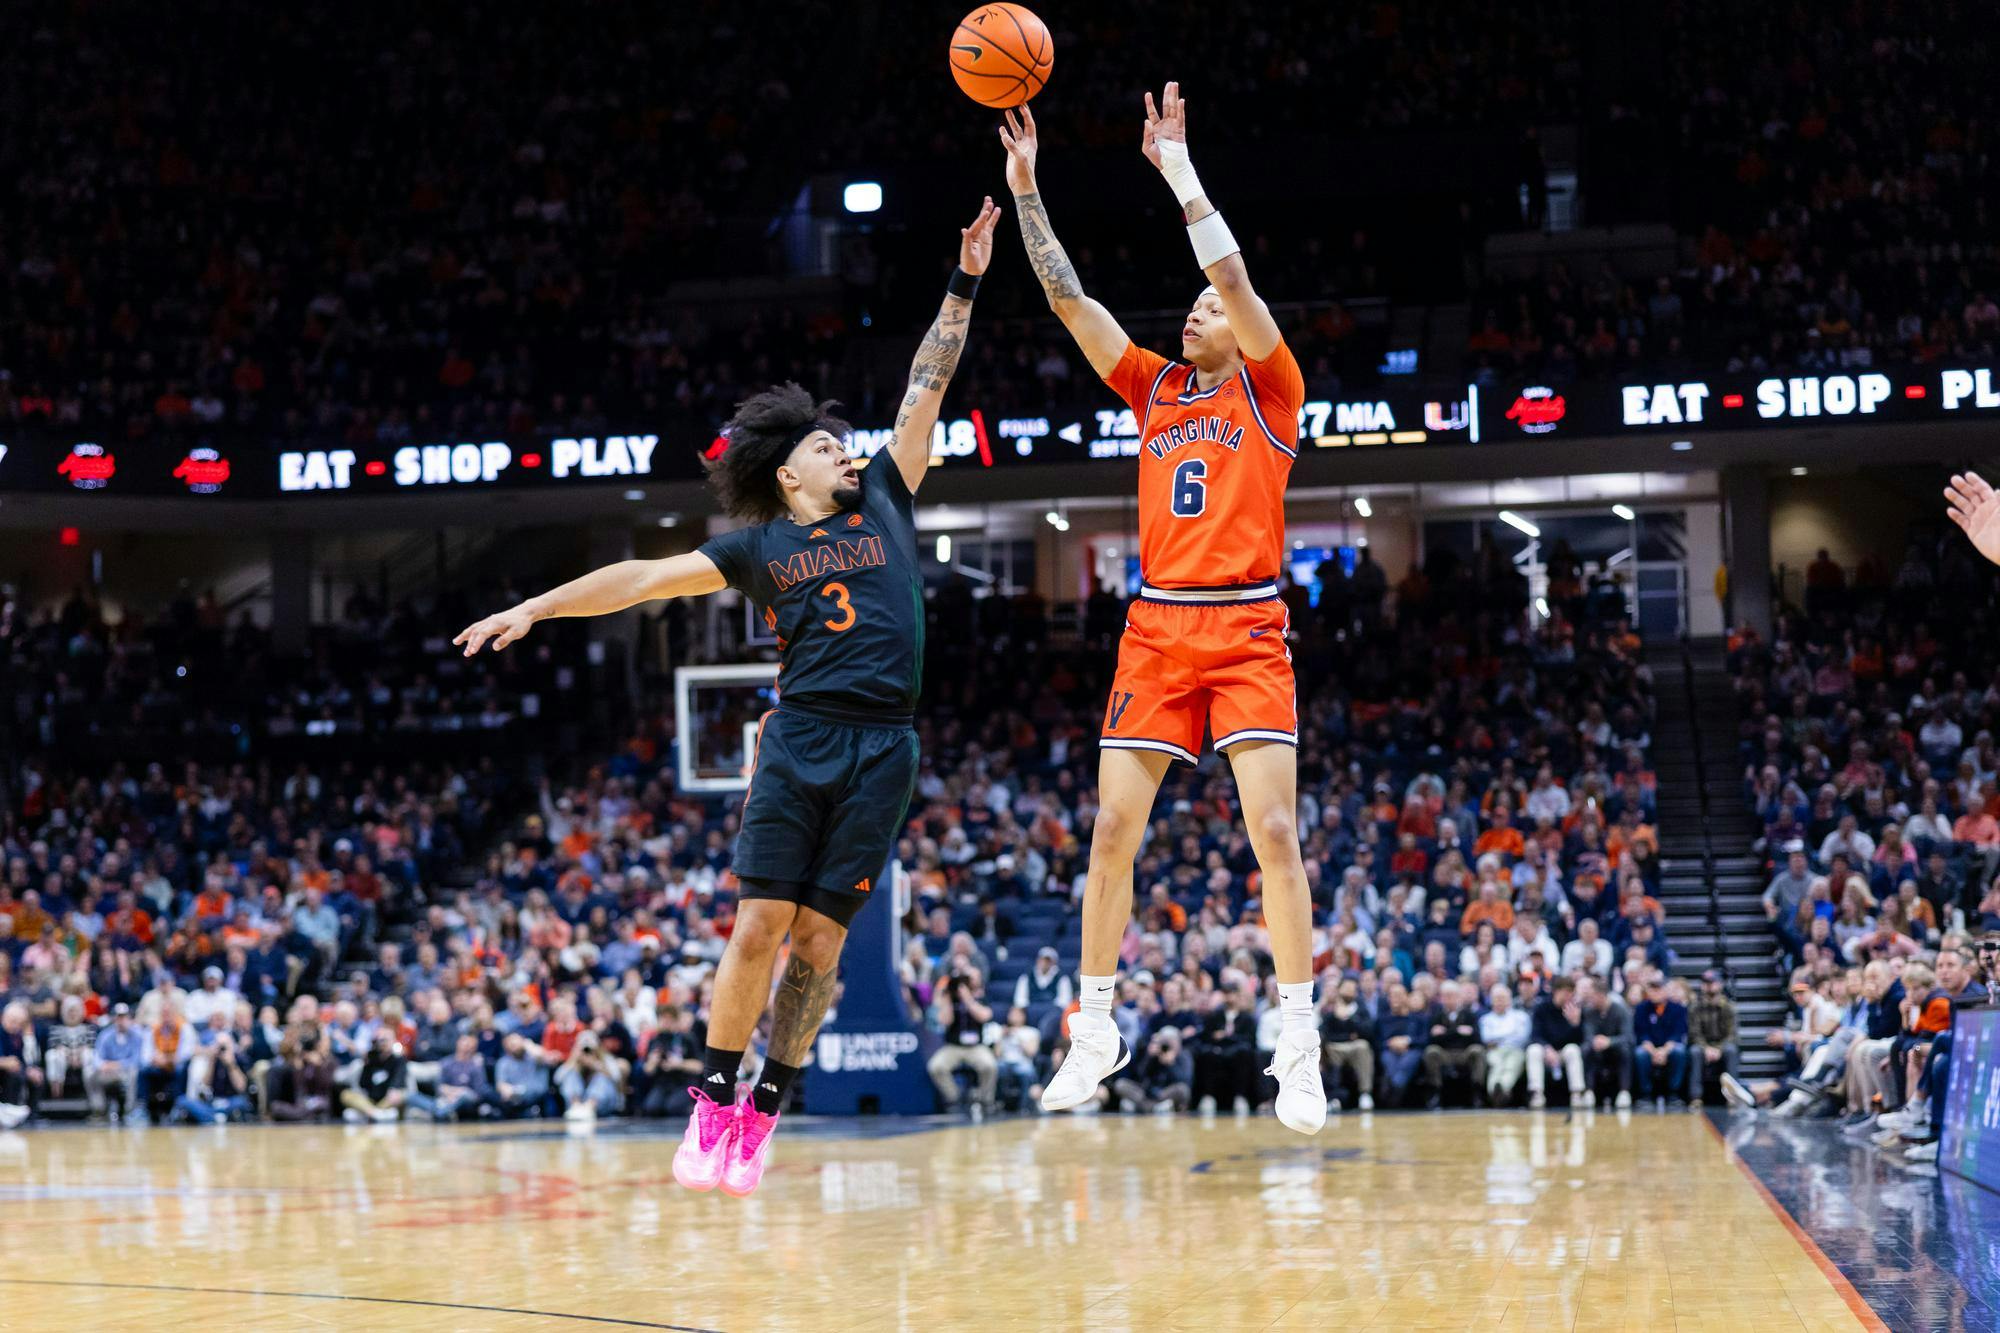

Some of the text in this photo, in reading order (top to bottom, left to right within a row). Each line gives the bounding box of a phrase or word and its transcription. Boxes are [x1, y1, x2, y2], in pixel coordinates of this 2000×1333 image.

[1336, 401, 1397, 433] MIA
[1622, 368, 2000, 425] EAT SHOP PL
[1147, 416, 1245, 461] VIRGINIA
[280, 450, 356, 491] EAT
[394, 442, 512, 486] SHOP
[551, 435, 658, 478] PLAY
[1171, 459, 1208, 518] 6
[768, 535, 887, 593] MIAMI
[821, 582, 856, 632] 3
[1107, 690, 1135, 730] V
[844, 1032, 918, 1053] UNITED
[844, 1053, 898, 1071] BANK
